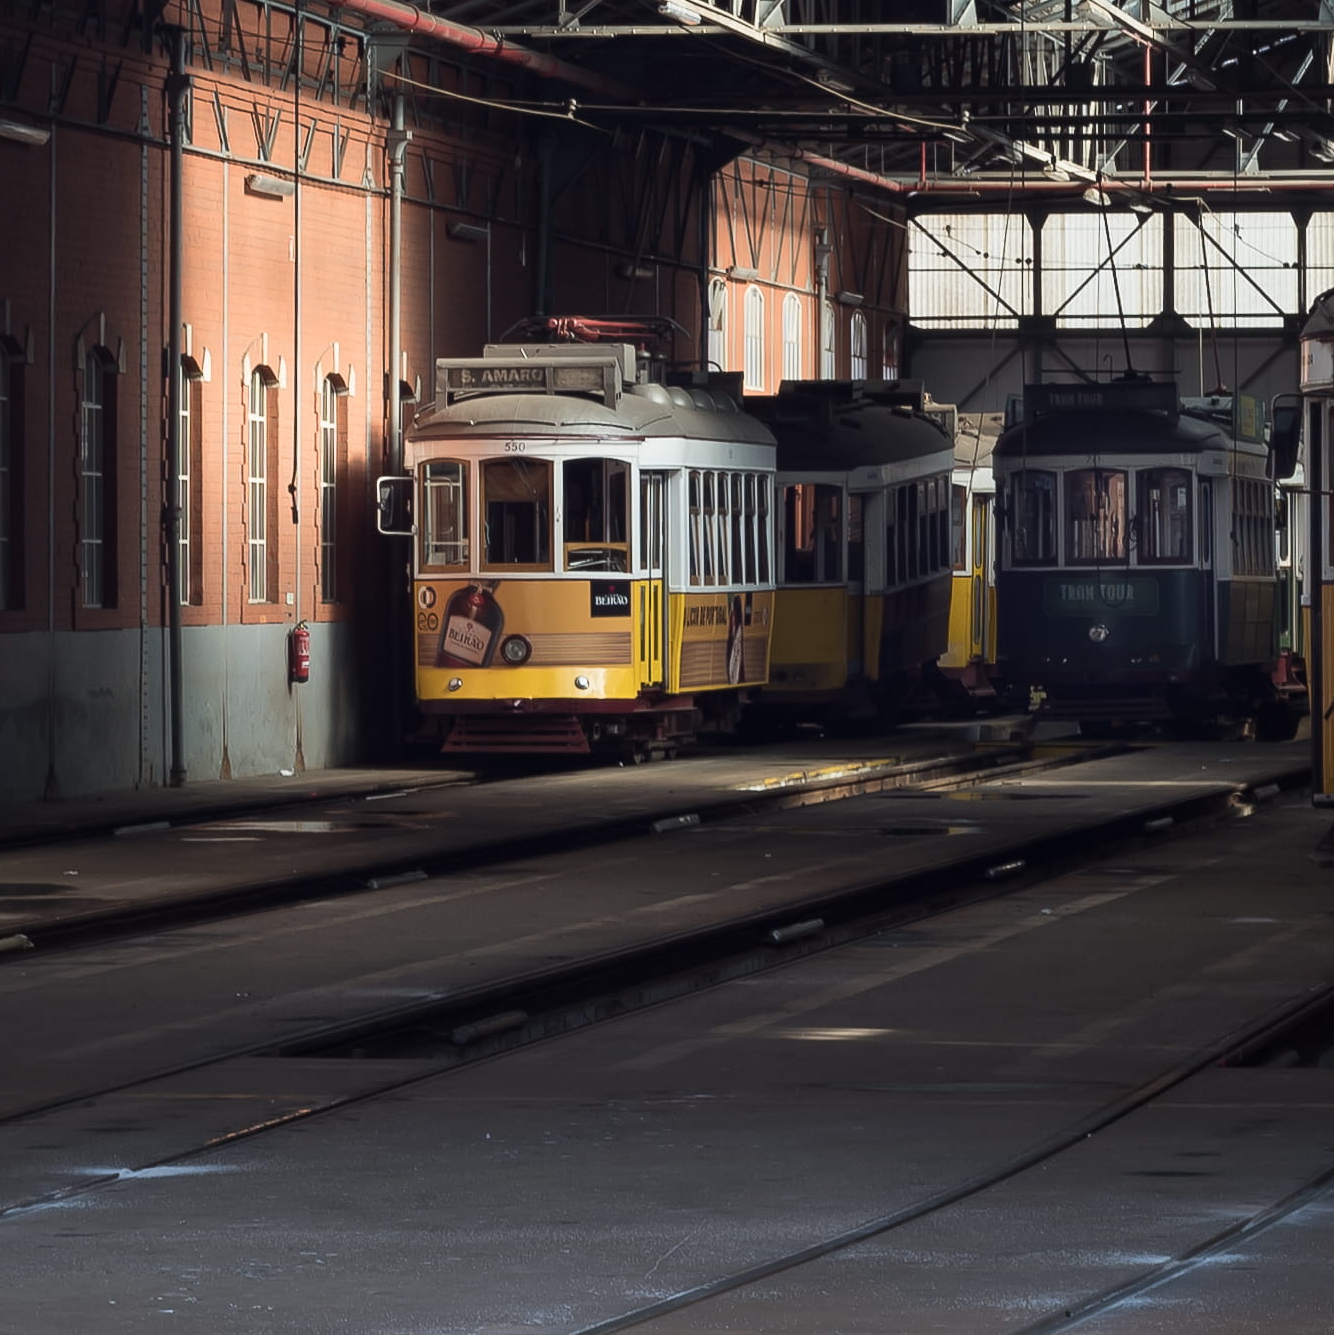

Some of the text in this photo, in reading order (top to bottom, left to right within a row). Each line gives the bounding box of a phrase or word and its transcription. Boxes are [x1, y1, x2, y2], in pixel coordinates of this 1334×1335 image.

[461, 368, 475, 383] S.
[481, 368, 543, 383] AMARO
[504, 442, 526, 452] 550
